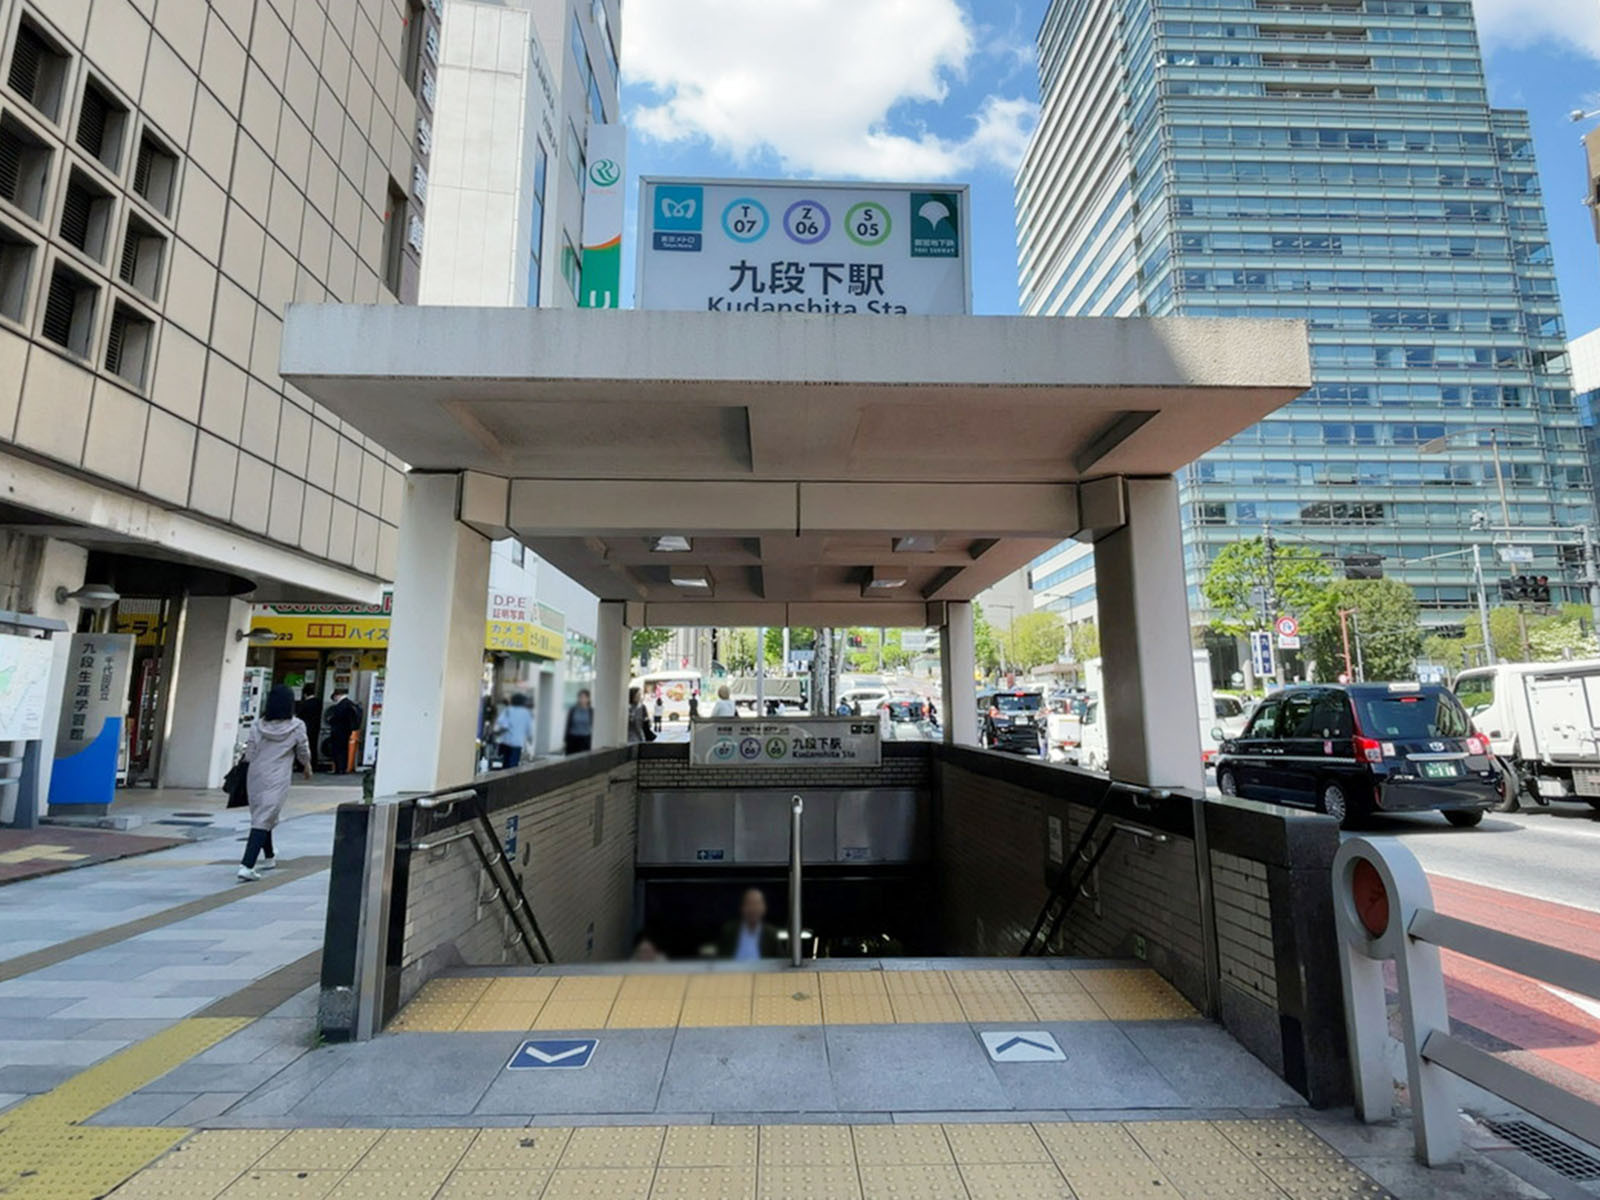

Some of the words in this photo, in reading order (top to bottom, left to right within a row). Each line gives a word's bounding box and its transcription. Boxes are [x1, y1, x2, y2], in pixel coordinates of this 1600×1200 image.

[741, 206, 750, 218] T
[802, 208, 812, 220] Z
[864, 209, 873, 221] S
[734, 220, 757, 233] 07
[795, 222, 818, 235] 06
[857, 223, 879, 236] 05
[729, 260, 884, 296] 九段下駅
[492, 624, 525, 635] カメラ
[792, 738, 842, 750] 九段下駅
